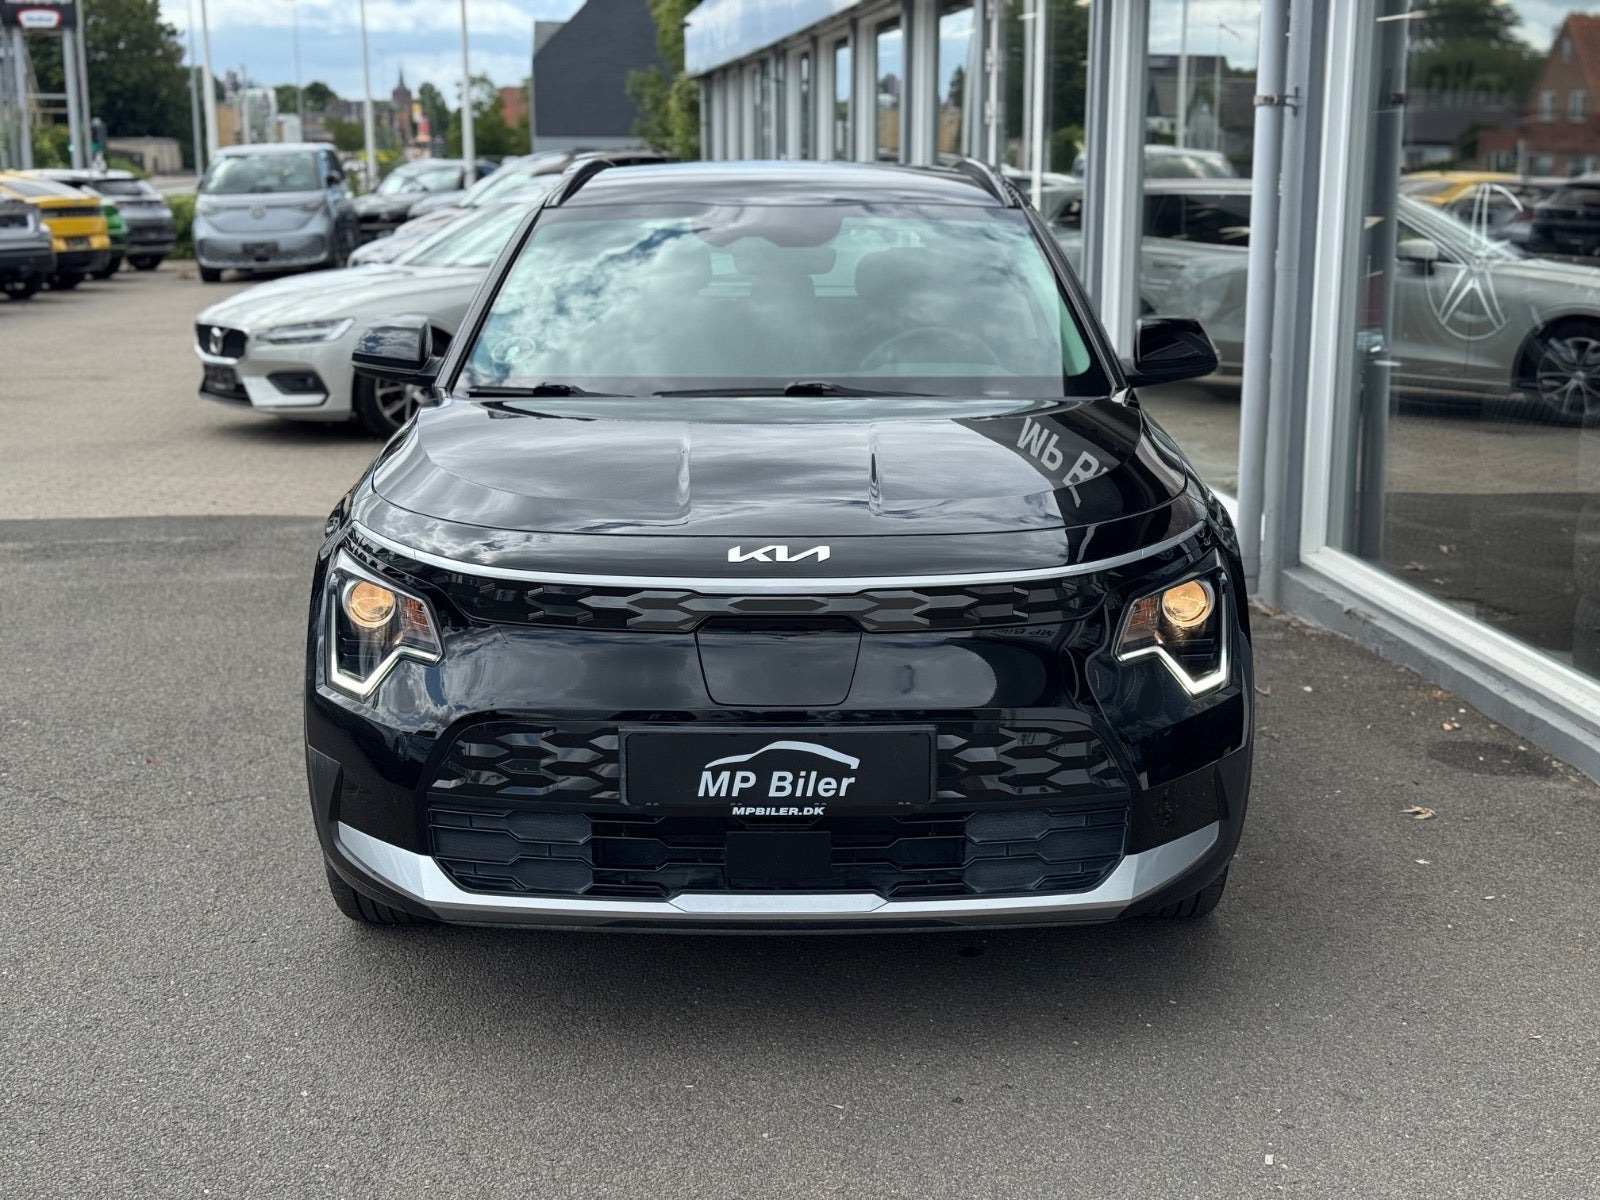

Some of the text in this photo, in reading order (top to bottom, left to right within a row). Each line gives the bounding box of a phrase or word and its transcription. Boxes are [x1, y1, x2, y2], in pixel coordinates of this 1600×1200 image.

[727, 545, 831, 562] KIA
[698, 770, 856, 797] MP Biler
[732, 806, 826, 816] MPBILER.DK
